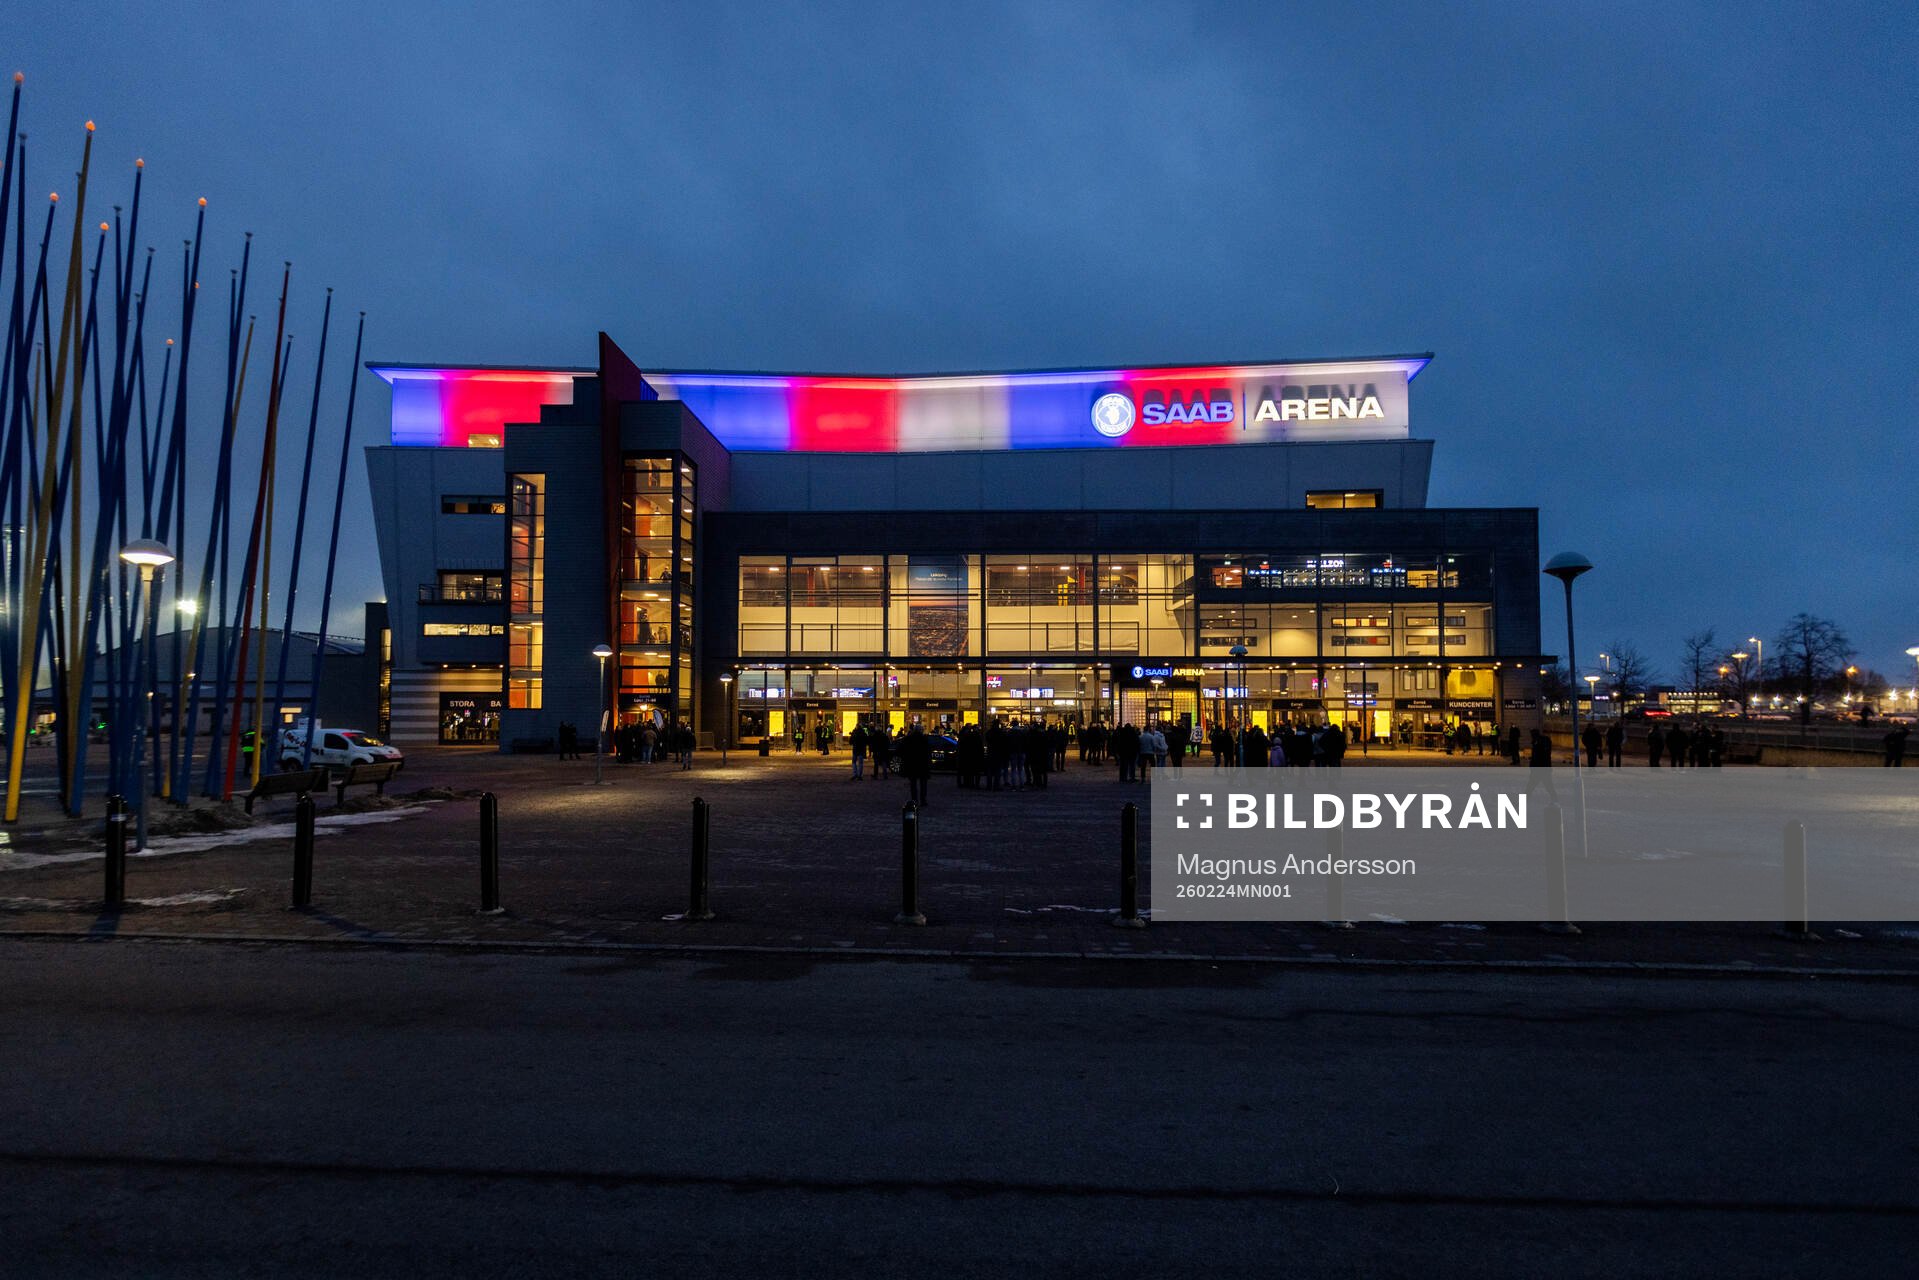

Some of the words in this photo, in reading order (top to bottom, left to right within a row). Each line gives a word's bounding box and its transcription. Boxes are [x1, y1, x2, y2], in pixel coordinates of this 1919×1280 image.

[1142, 401, 1234, 425] SAAB
[1254, 397, 1385, 422] ARENA
[1144, 668, 1169, 676] SAAB
[1173, 668, 1205, 676] ARENA
